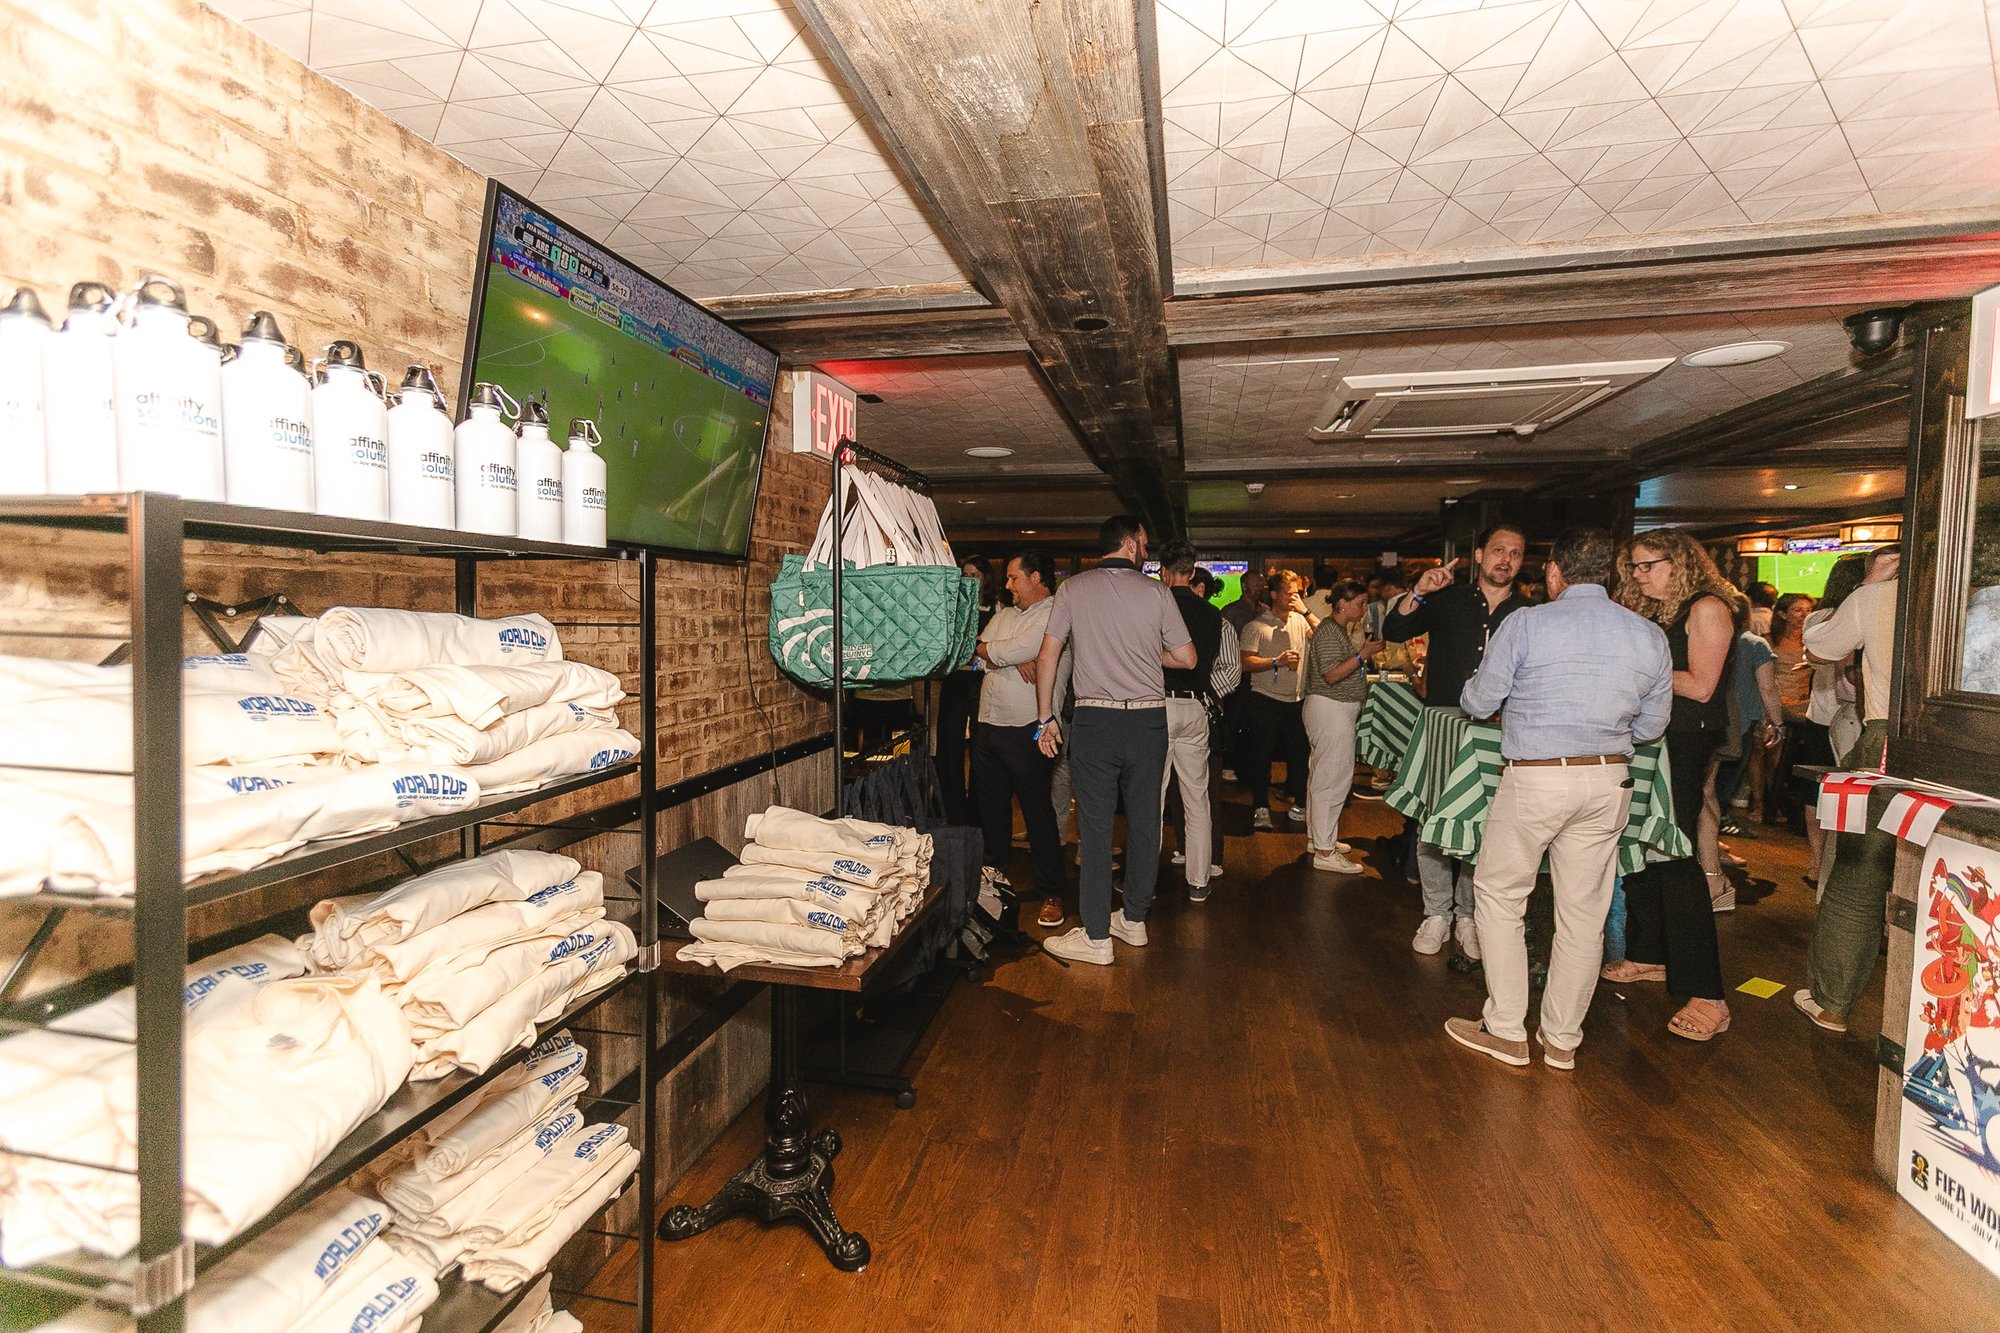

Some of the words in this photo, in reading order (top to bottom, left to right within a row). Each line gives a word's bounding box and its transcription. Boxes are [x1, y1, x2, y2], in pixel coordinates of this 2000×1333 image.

[526, 222, 536, 233] FIFA
[537, 228, 554, 242] WORLD
[554, 236, 562, 246] CUP
[535, 238, 550, 255] ARG
[580, 264, 593, 277] CPV
[526, 268, 560, 294] Valvoline
[136, 391, 205, 415] afity
[816, 382, 854, 462] EXIT
[498, 628, 530, 646] WORLD
[530, 630, 546, 648] CUP
[237, 696, 290, 712] WORLD
[286, 698, 318, 713] CUP
[590, 749, 620, 769] WORLD
[392, 774, 440, 794] WORLD
[442, 774, 468, 796] CUP
[834, 860, 860, 873] WORLD
[858, 862, 872, 876] CUP
[832, 884, 847, 897] CUP
[808, 911, 835, 927] WORLD
[832, 916, 848, 931] CUP
[576, 934, 595, 949] CUP
[231, 962, 268, 978] CUP
[550, 1036, 574, 1050] CUP
[534, 1118, 564, 1150] WORLD
[560, 1112, 576, 1130] CUP
[574, 1134, 606, 1158] WORLD
[1936, 1166, 1966, 1208] FIFA
[1934, 1192, 1954, 1213] JUNE
[1956, 1208, 1964, 1221] 11
[1972, 1222, 1992, 1243] JULY
[314, 1228, 362, 1279] WORLD
[354, 1213, 382, 1239] CUP
[349, 1294, 396, 1333] WORLD
[386, 1276, 417, 1299] CUP
